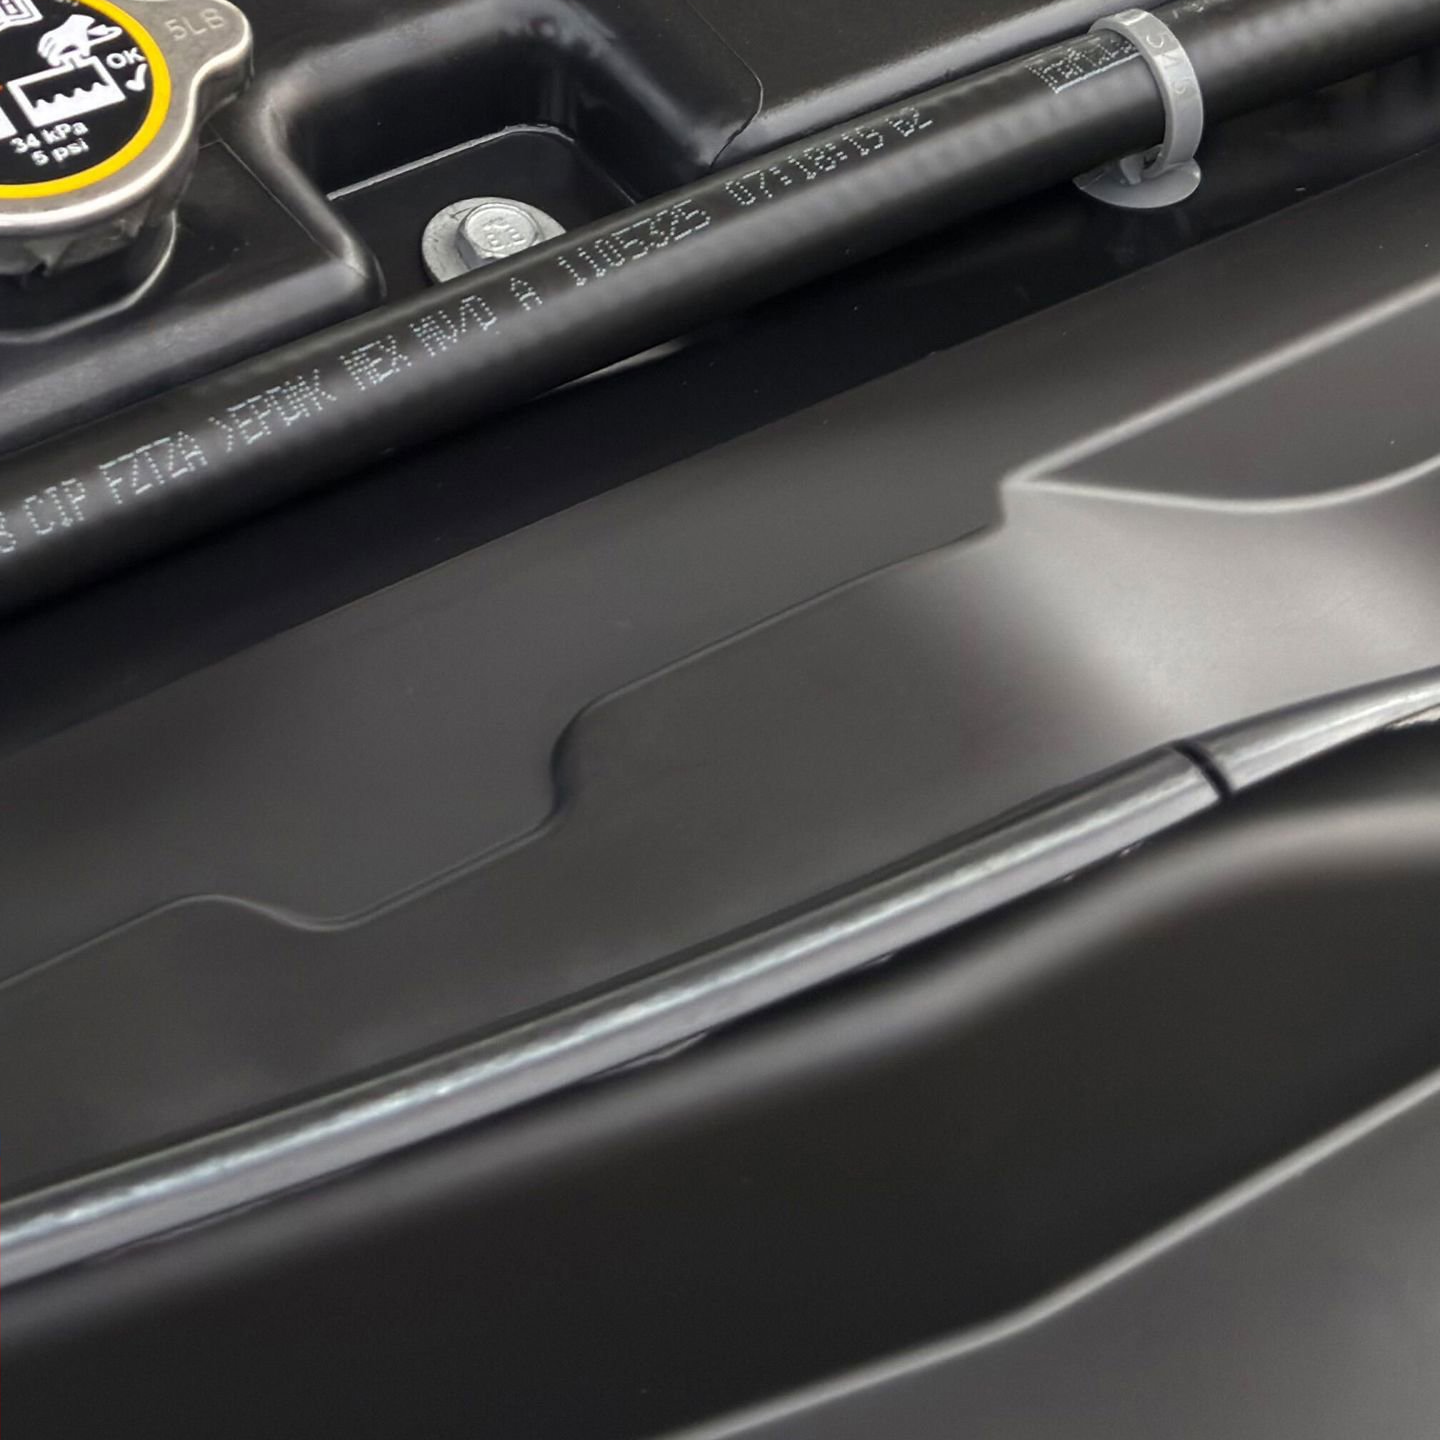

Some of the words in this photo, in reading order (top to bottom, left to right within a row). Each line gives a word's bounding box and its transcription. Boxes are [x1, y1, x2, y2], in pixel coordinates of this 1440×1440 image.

[165, 7, 225, 43] 5LB
[106, 47, 144, 71] OK
[10, 134, 40, 155] 34
[41, 121, 90, 146] kPa
[31, 149, 50, 166] 5
[54, 139, 90, 163] psi
